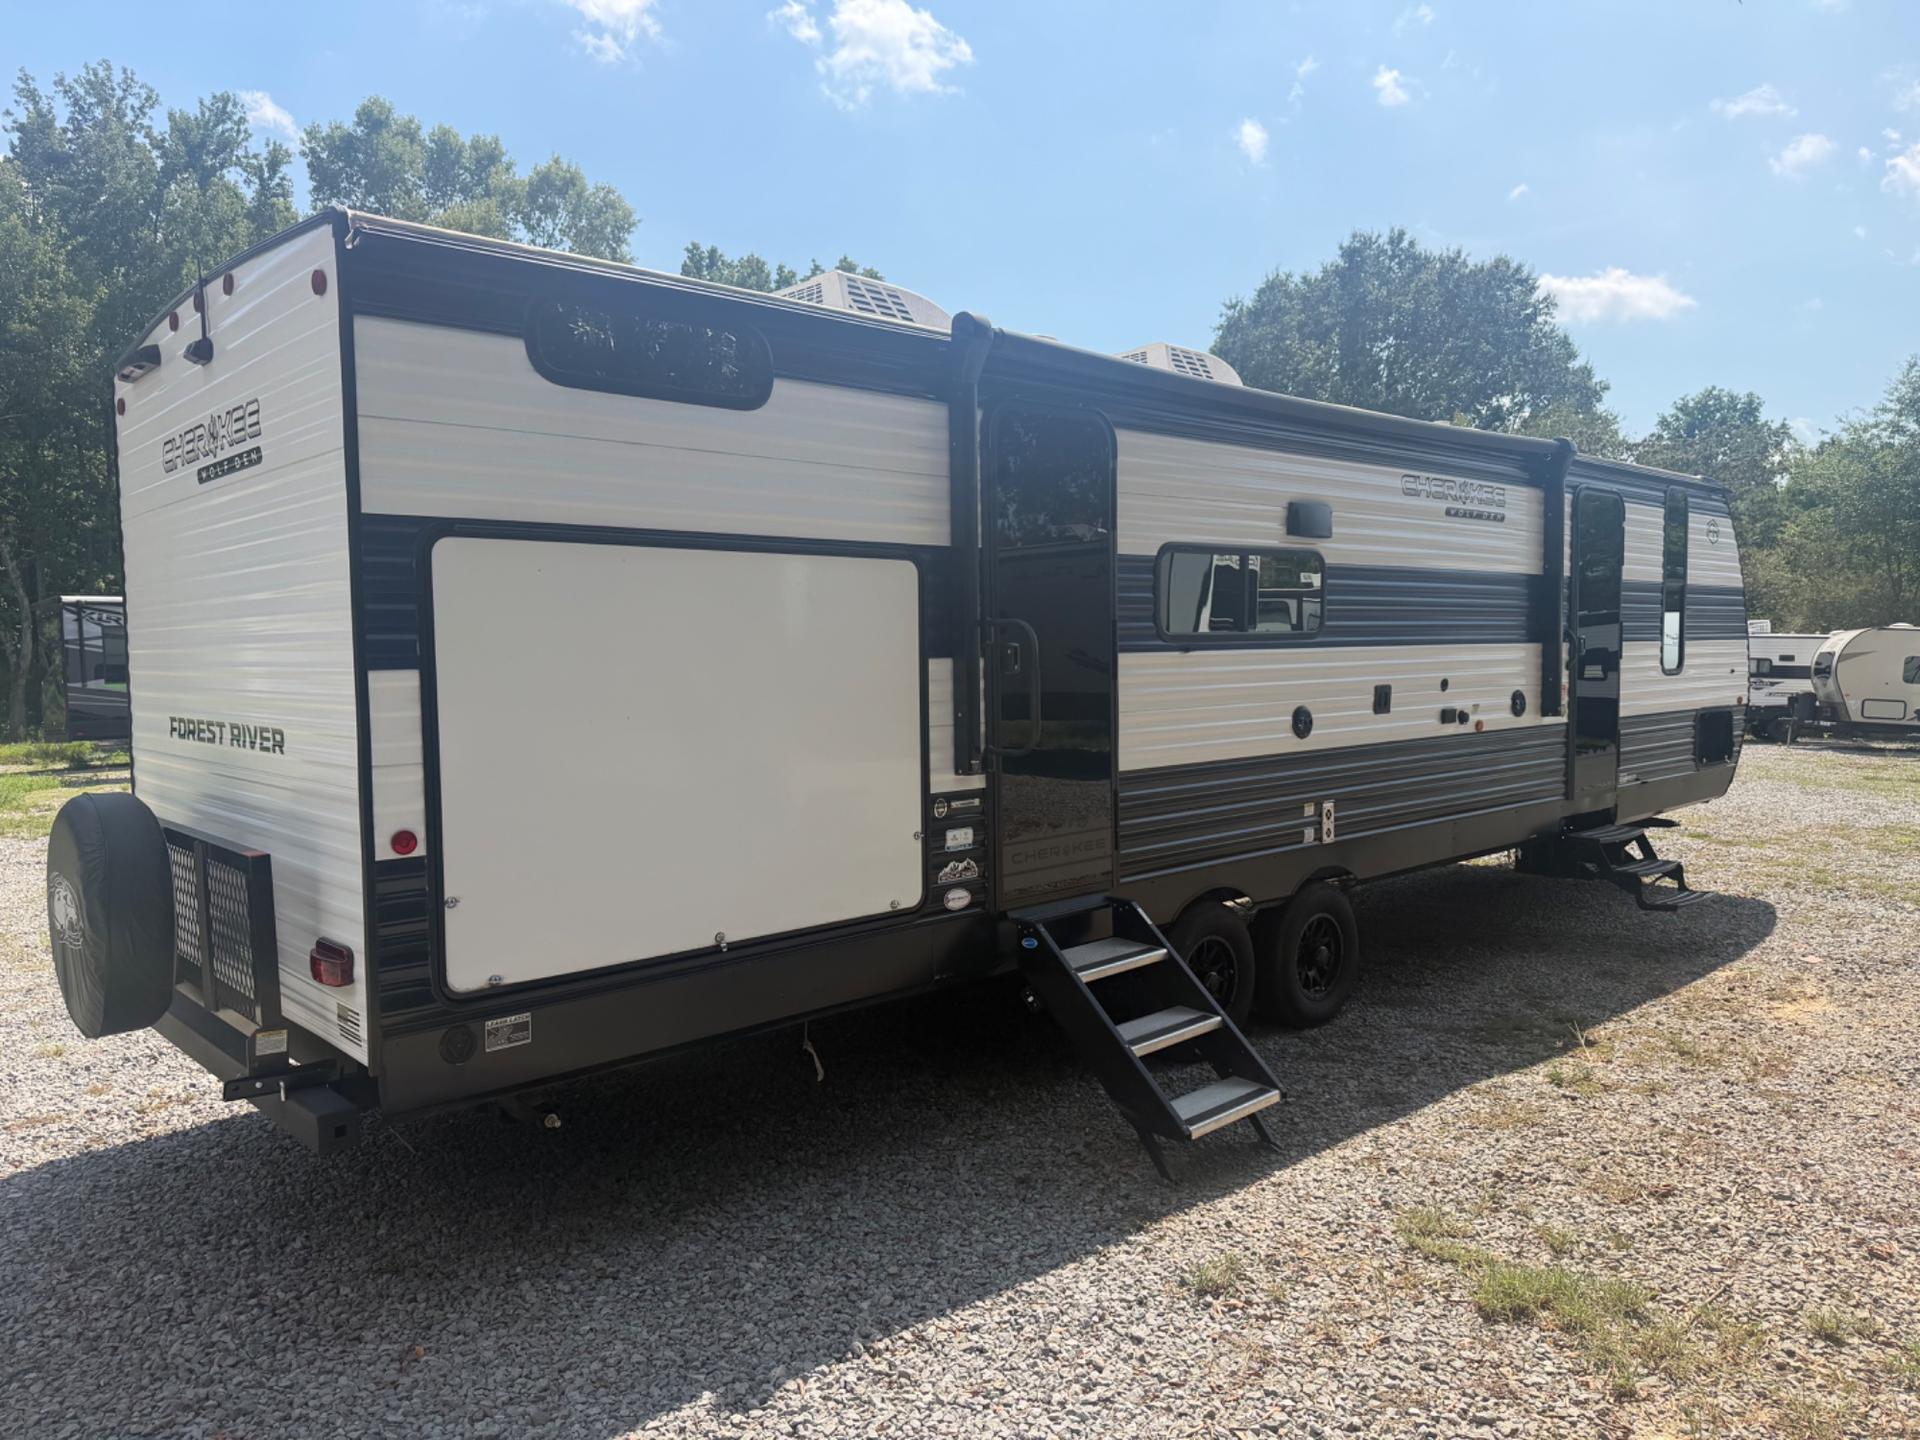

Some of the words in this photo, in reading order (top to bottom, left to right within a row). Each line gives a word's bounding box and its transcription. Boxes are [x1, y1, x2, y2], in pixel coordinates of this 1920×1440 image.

[162, 398, 261, 474] CHEROKEE
[200, 460, 229, 480] WOLF
[234, 449, 259, 469] DEN
[1400, 474, 1505, 507] CHEROKEE
[168, 716, 226, 745] FOREST
[228, 722, 285, 755] RIVER
[1011, 838, 1105, 864] CHEROKEE
